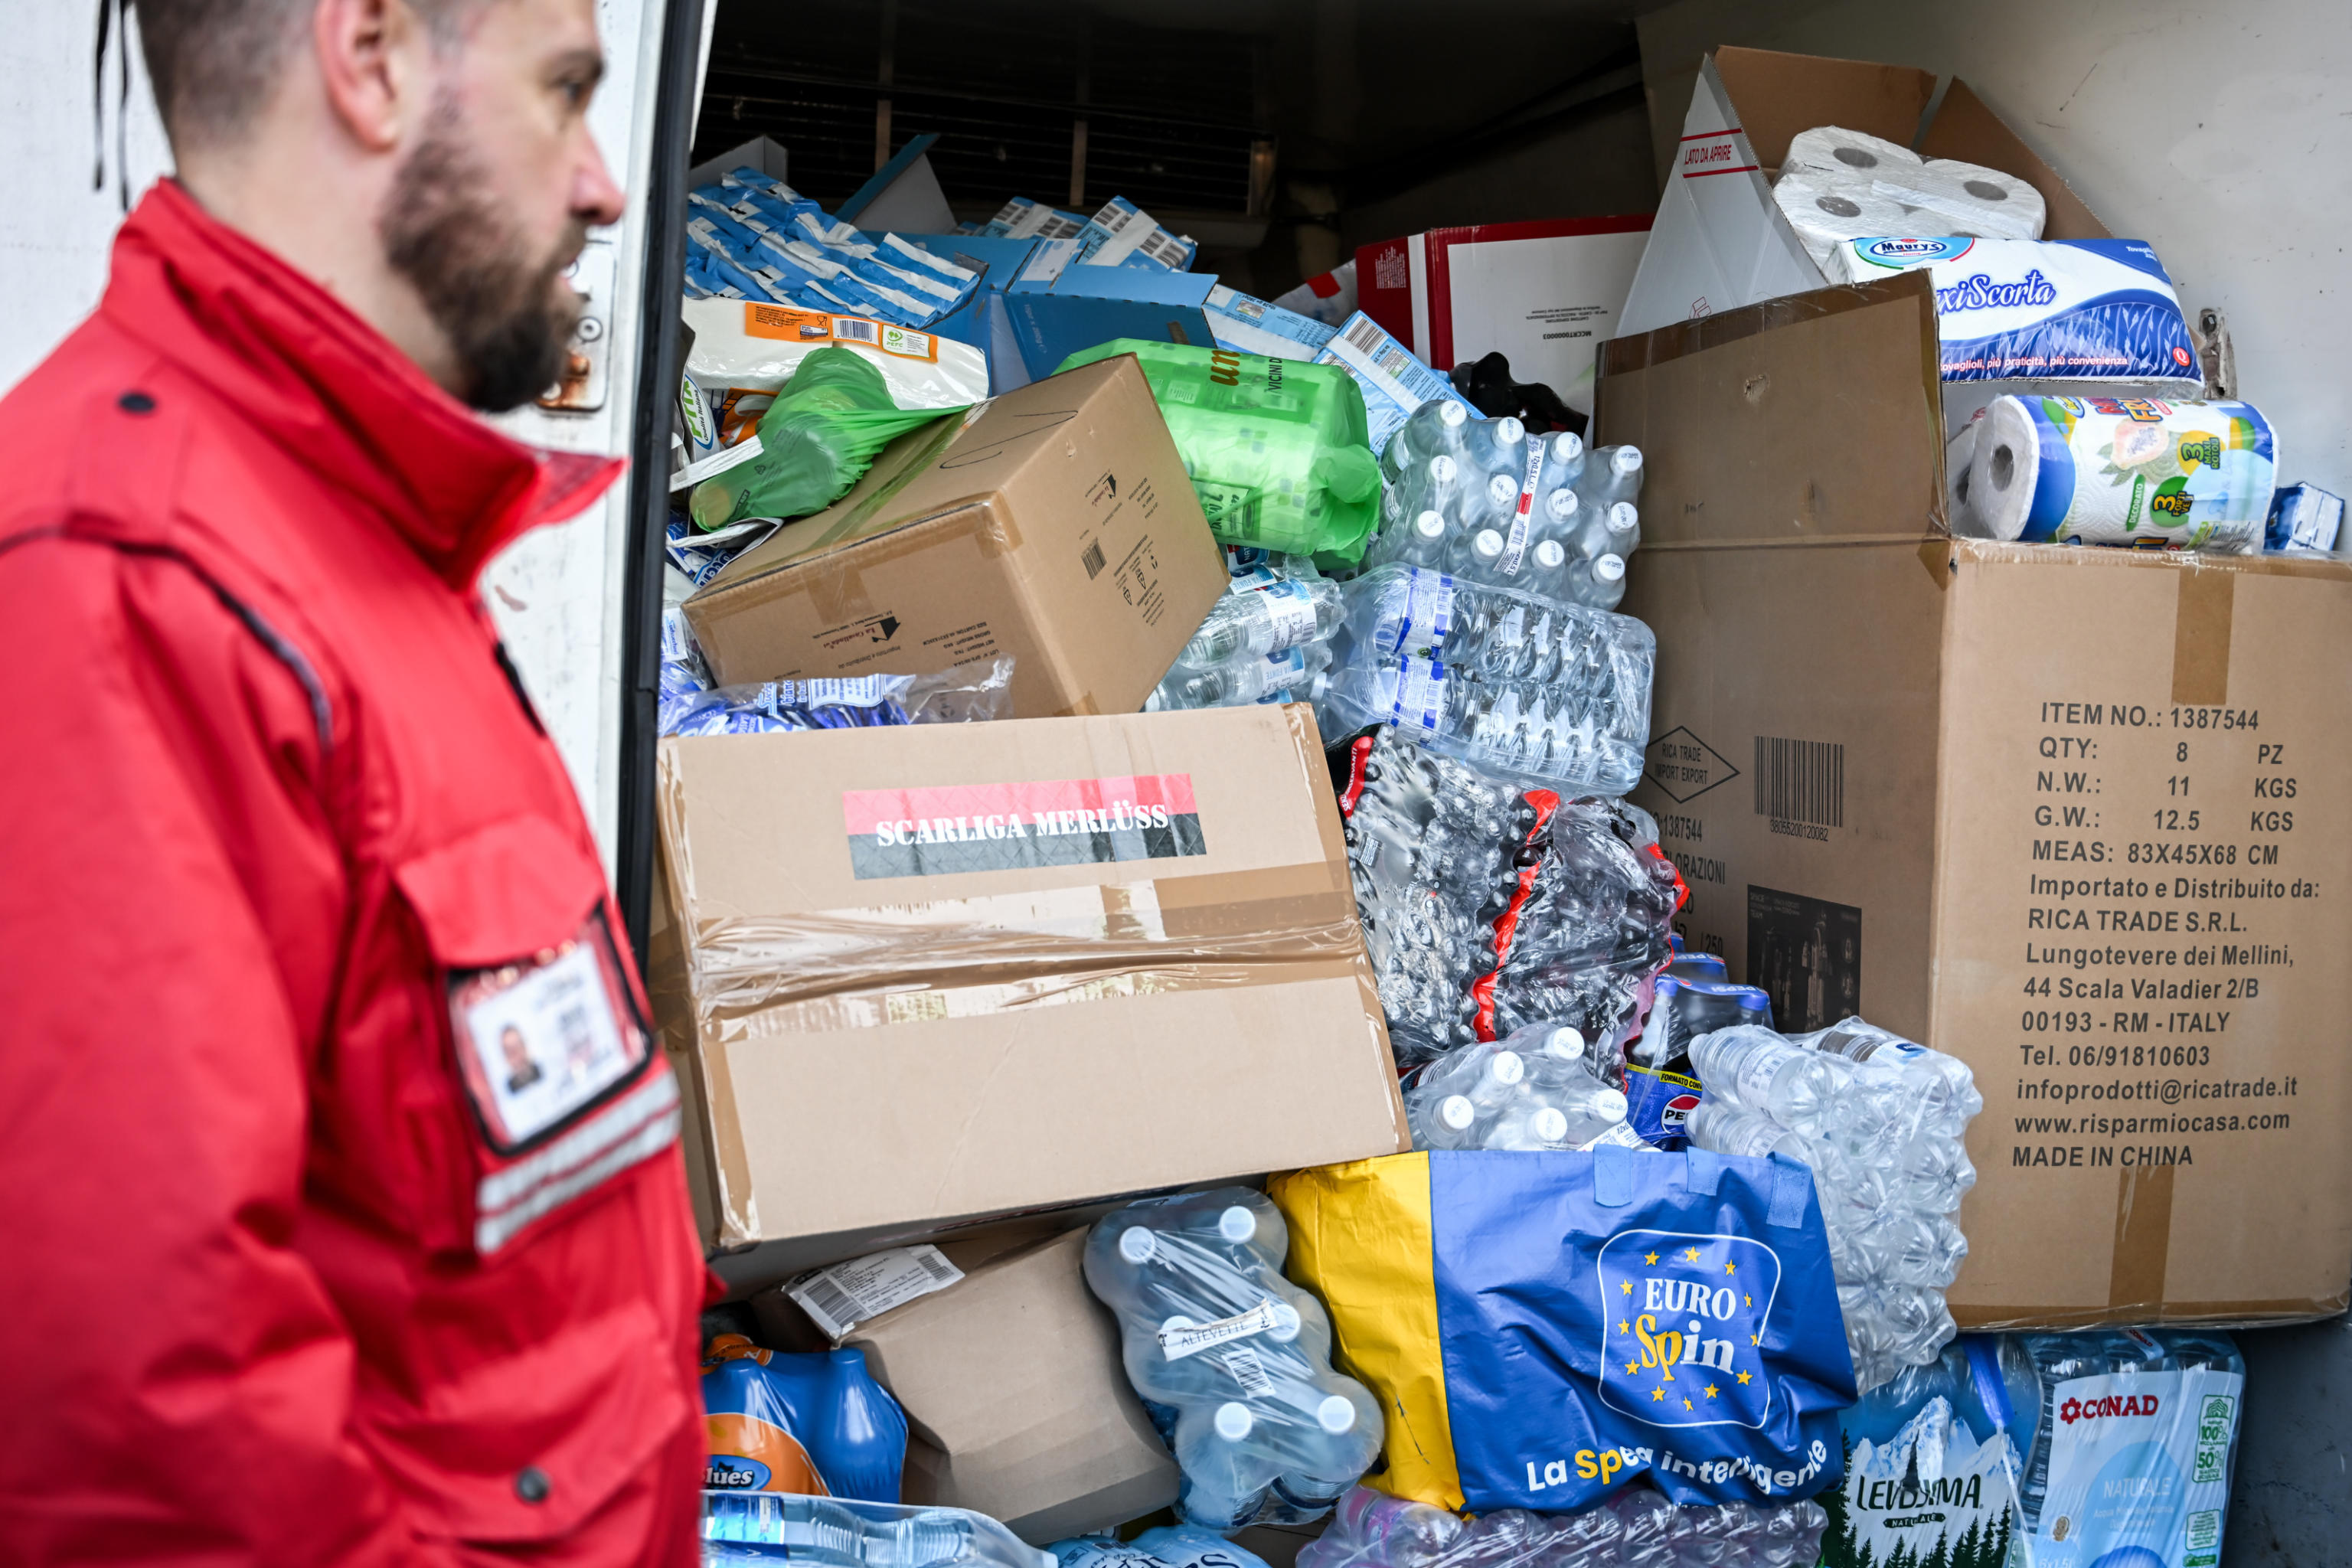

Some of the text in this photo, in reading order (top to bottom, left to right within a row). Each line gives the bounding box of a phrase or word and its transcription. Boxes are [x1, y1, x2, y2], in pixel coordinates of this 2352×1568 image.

[1684, 144, 1732, 165] LATO DA APRIRE
[1881, 242, 1941, 252] Maury's
[1988, 357, 2002, 369] più
[2004, 356, 2047, 369] praticità,
[2050, 356, 2065, 368] più
[2067, 357, 2128, 366] convenienza
[1268, 364, 1282, 390] VICINI
[693, 390, 709, 443] Qualità Italiana
[2182, 442, 2207, 463] 3
[2203, 441, 2211, 466] MAXI
[2210, 437, 2220, 471] ROTOLI
[2128, 482, 2144, 524] DECORATO
[2152, 494, 2177, 514] 3
[2040, 701, 2259, 731] ITEM NO.: 1387544
[1662, 743, 1701, 763] RICA TRADE
[2038, 736, 2284, 766] QTY: 8 PZ
[1681, 766, 1708, 786] EXPORT
[2036, 771, 2298, 799] N.W.: 11 KGS
[876, 799, 1169, 847] SCARLIGA MERLÜSS
[2034, 805, 2294, 832] G.W.: 12.5 KGS
[2032, 840, 2278, 867] MEAS: 83X45X68 CM
[2030, 874, 2321, 901] Importato e Distribuito da:
[2027, 908, 2248, 933] RICA TRADE S.R.L.
[2026, 942, 2295, 970] Lungotevere dei Mellini,
[2023, 977, 2259, 1000] 44 Scala Valadier 2/B
[2021, 1011, 2092, 1033] 00193
[2112, 1012, 2148, 1034] RM
[2168, 1011, 2230, 1034] ITALY
[2020, 1044, 2210, 1068] Tel. 06/91810603
[1661, 1073, 1689, 1086] FORMATO
[2017, 1076, 2298, 1105] infoprodotti@ricatrade.it
[2014, 1112, 2290, 1137] www.risparmiocasa.com
[2012, 1145, 2194, 1168] MADE IN CHINA
[1643, 1277, 1736, 1321] EURO
[1635, 1313, 1734, 1382] Spin
[2082, 1393, 2159, 1419] CONAD
[2200, 1425, 2228, 1442] 100%
[2196, 1452, 2223, 1470] 50%
[1527, 1459, 1567, 1491] La
